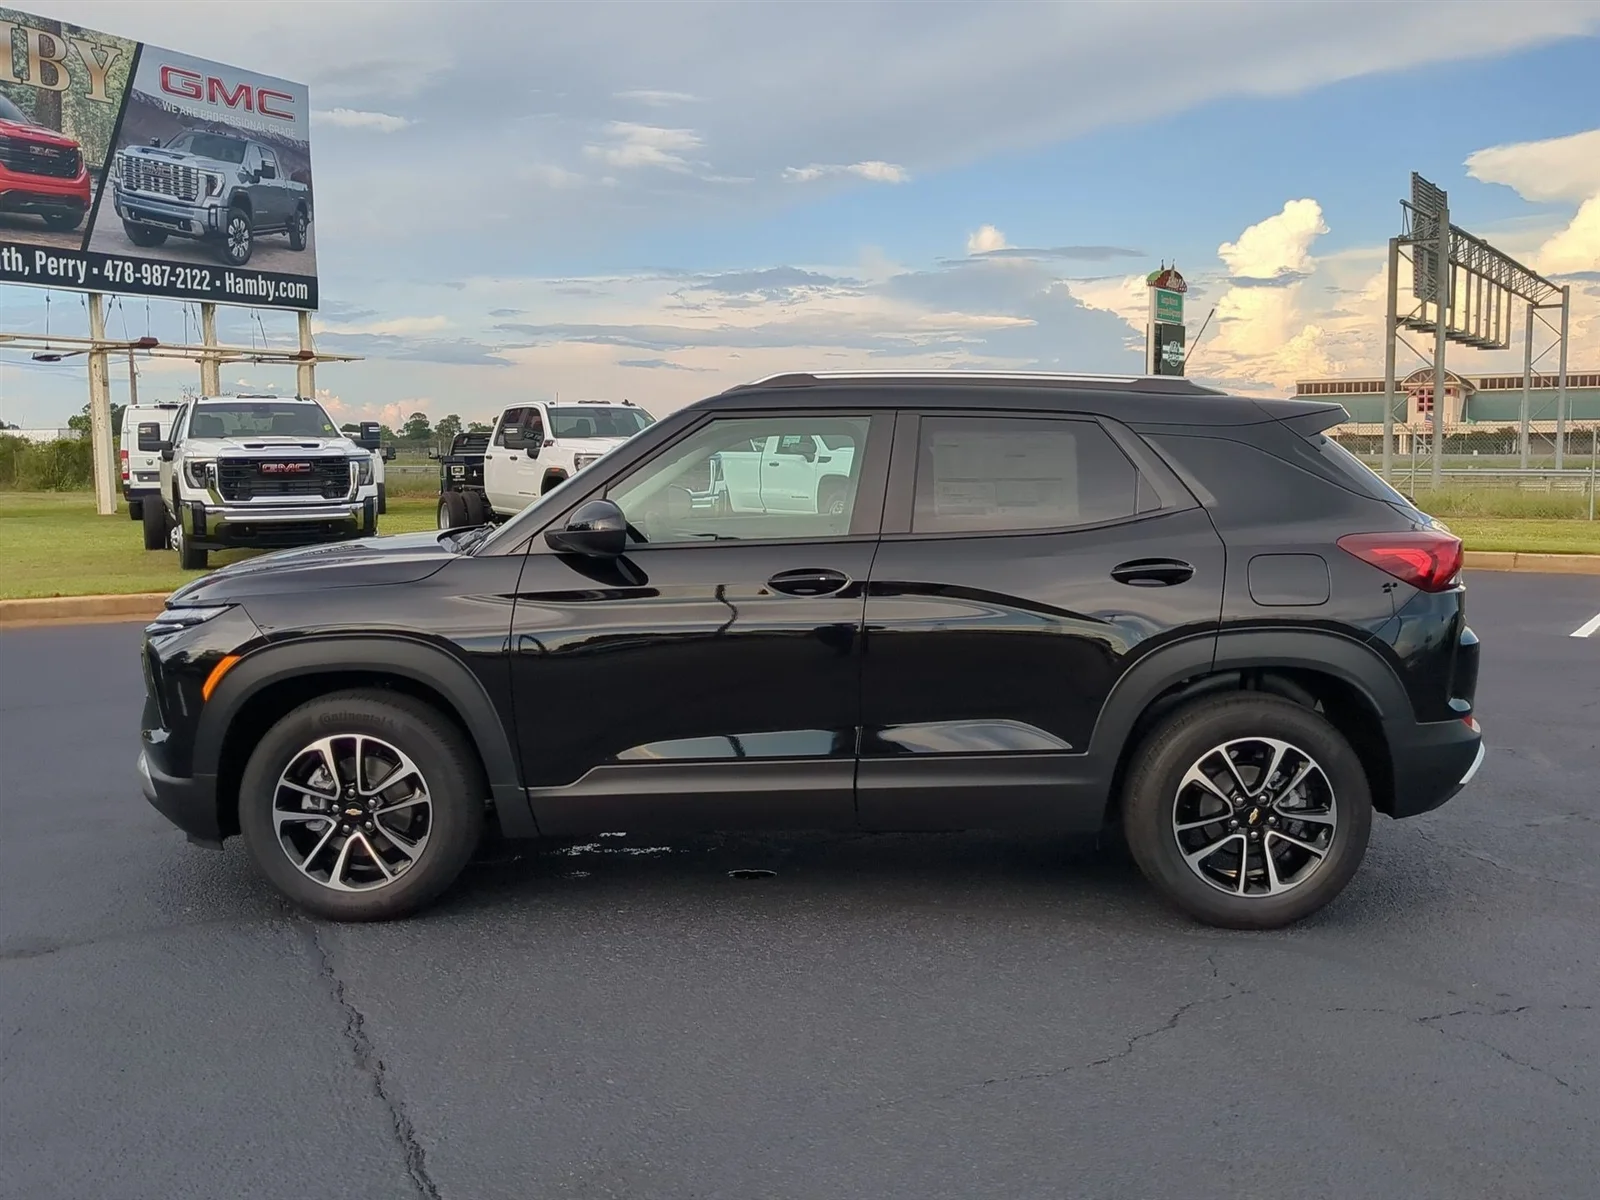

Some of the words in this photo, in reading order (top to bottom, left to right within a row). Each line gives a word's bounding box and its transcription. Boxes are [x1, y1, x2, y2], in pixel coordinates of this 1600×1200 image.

[159, 64, 296, 122] GMC
[162, 100, 178, 114] WE
[180, 107, 200, 117] ARE
[201, 109, 267, 132] PROFESSIONAL
[268, 123, 296, 138] GRADE
[0, 246, 30, 276] th,
[34, 250, 87, 284] Perry
[103, 259, 211, 290] 478-987-2122
[225, 271, 308, 302] Hamby.com
[262, 463, 310, 473] GMC
